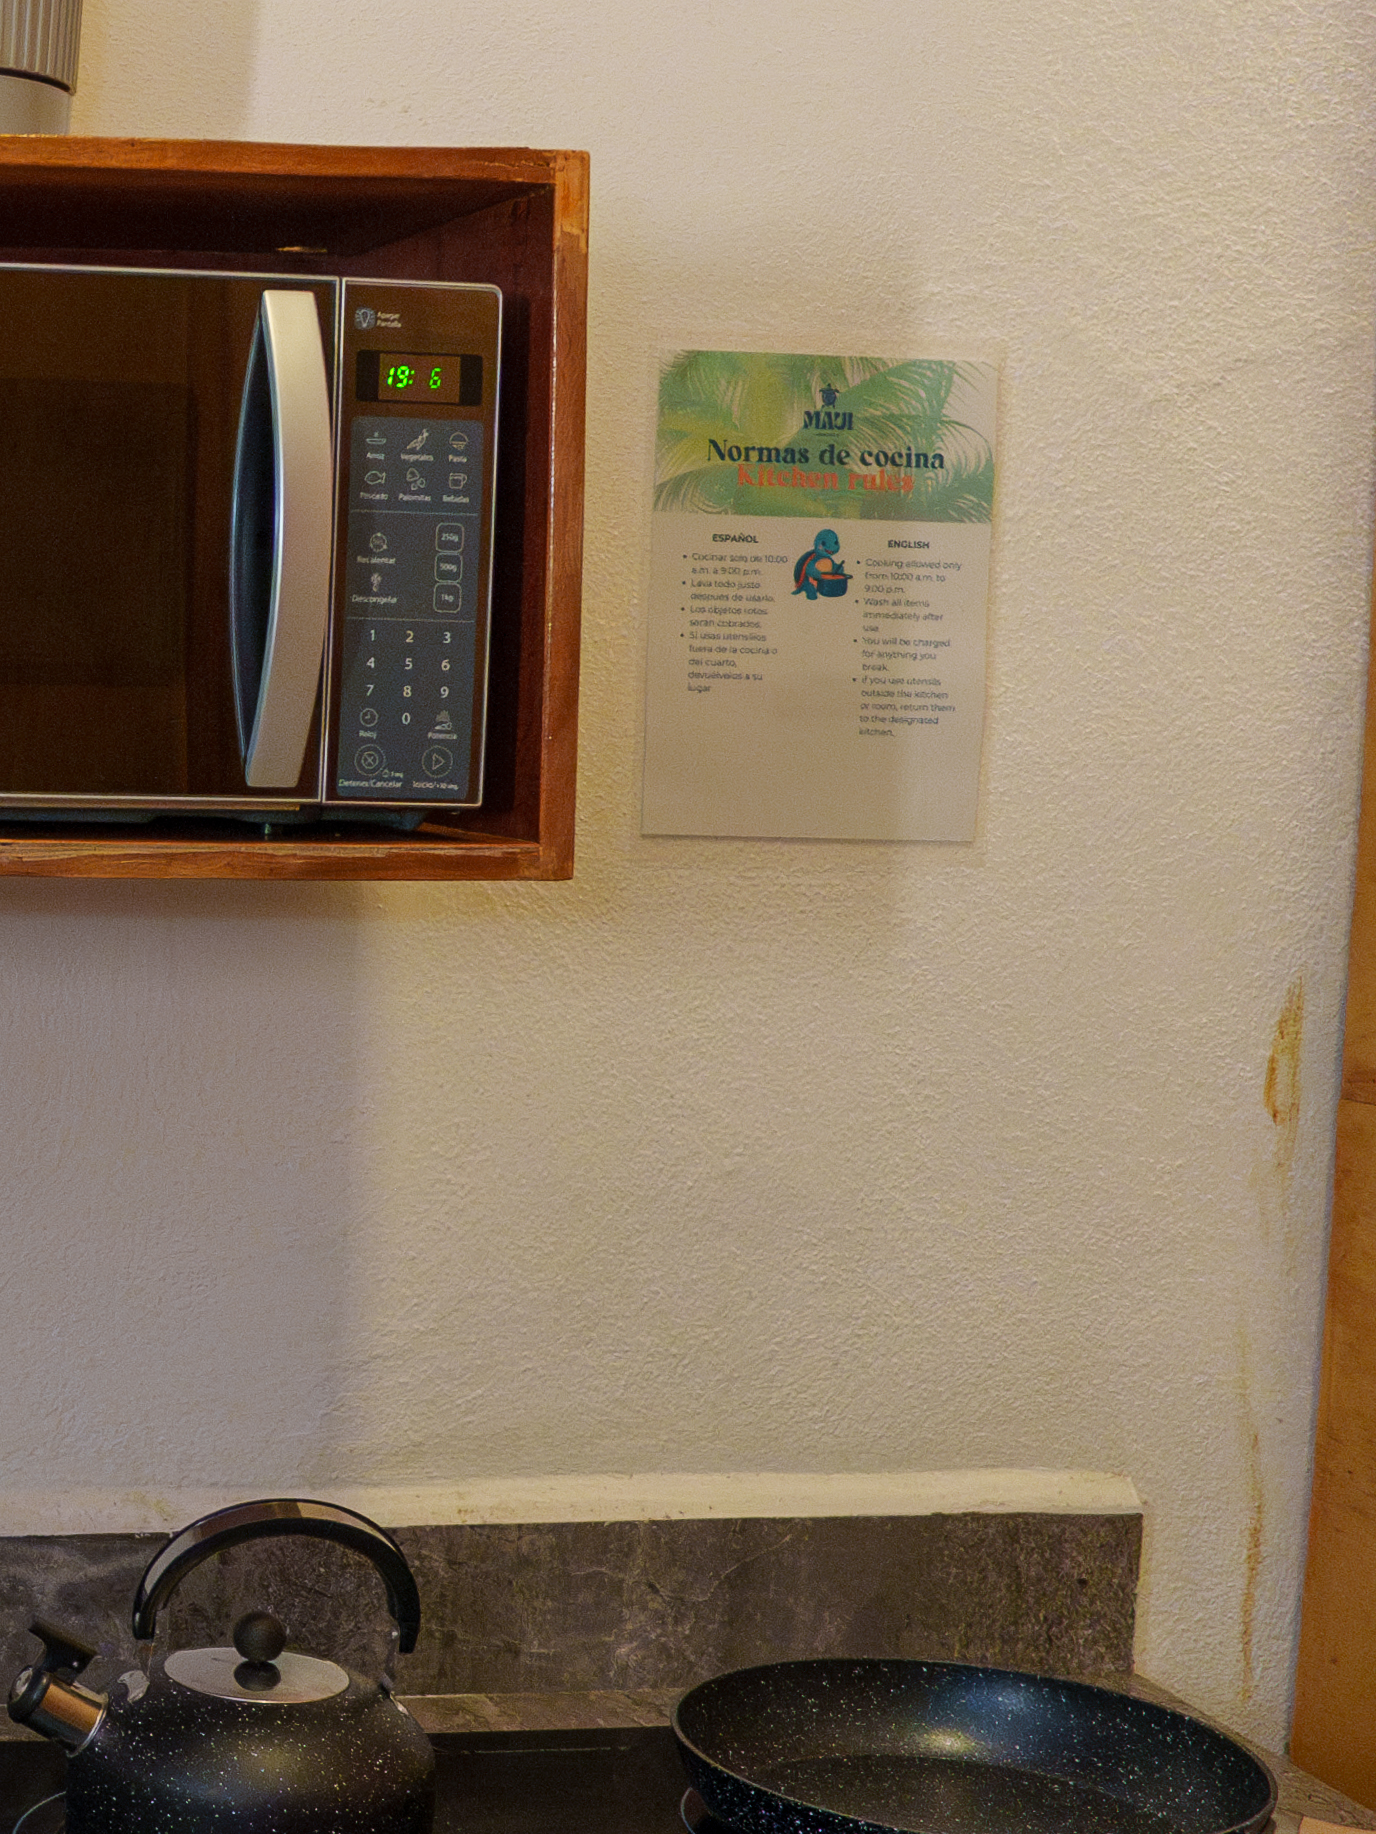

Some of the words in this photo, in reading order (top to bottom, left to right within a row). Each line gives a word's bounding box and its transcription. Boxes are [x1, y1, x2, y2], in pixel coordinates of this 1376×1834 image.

[429, 367, 441, 389] 6
[803, 410, 854, 430] MAUI
[707, 438, 809, 465] Normas
[819, 444, 850, 465] de
[859, 446, 944, 469] cocina
[738, 464, 838, 490] Kitchen
[848, 469, 914, 492] rules
[712, 533, 759, 543] ESPAÑOL
[888, 540, 930, 549] ENGLISH
[866, 558, 903, 569] Cooking
[943, 561, 962, 571] only
[863, 598, 889, 607] Wash
[863, 611, 920, 621] immediately
[370, 630, 375, 641] 1
[406, 630, 414, 643] 2
[443, 632, 451, 645] 3
[862, 638, 880, 646] You
[882, 638, 897, 646] will
[899, 638, 911, 646] be
[913, 639, 951, 648] charged
[877, 651, 917, 662] anything
[919, 653, 937, 661] you
[366, 657, 375, 669] 4
[405, 658, 413, 670] 5
[441, 659, 450, 672] 6
[869, 677, 886, 687] you
[366, 685, 375, 697] 7
[403, 685, 412, 698] 8
[440, 686, 449, 699] 9
[914, 691, 949, 699] kitchen
[402, 712, 411, 725] 0
[889, 716, 939, 727] designated
